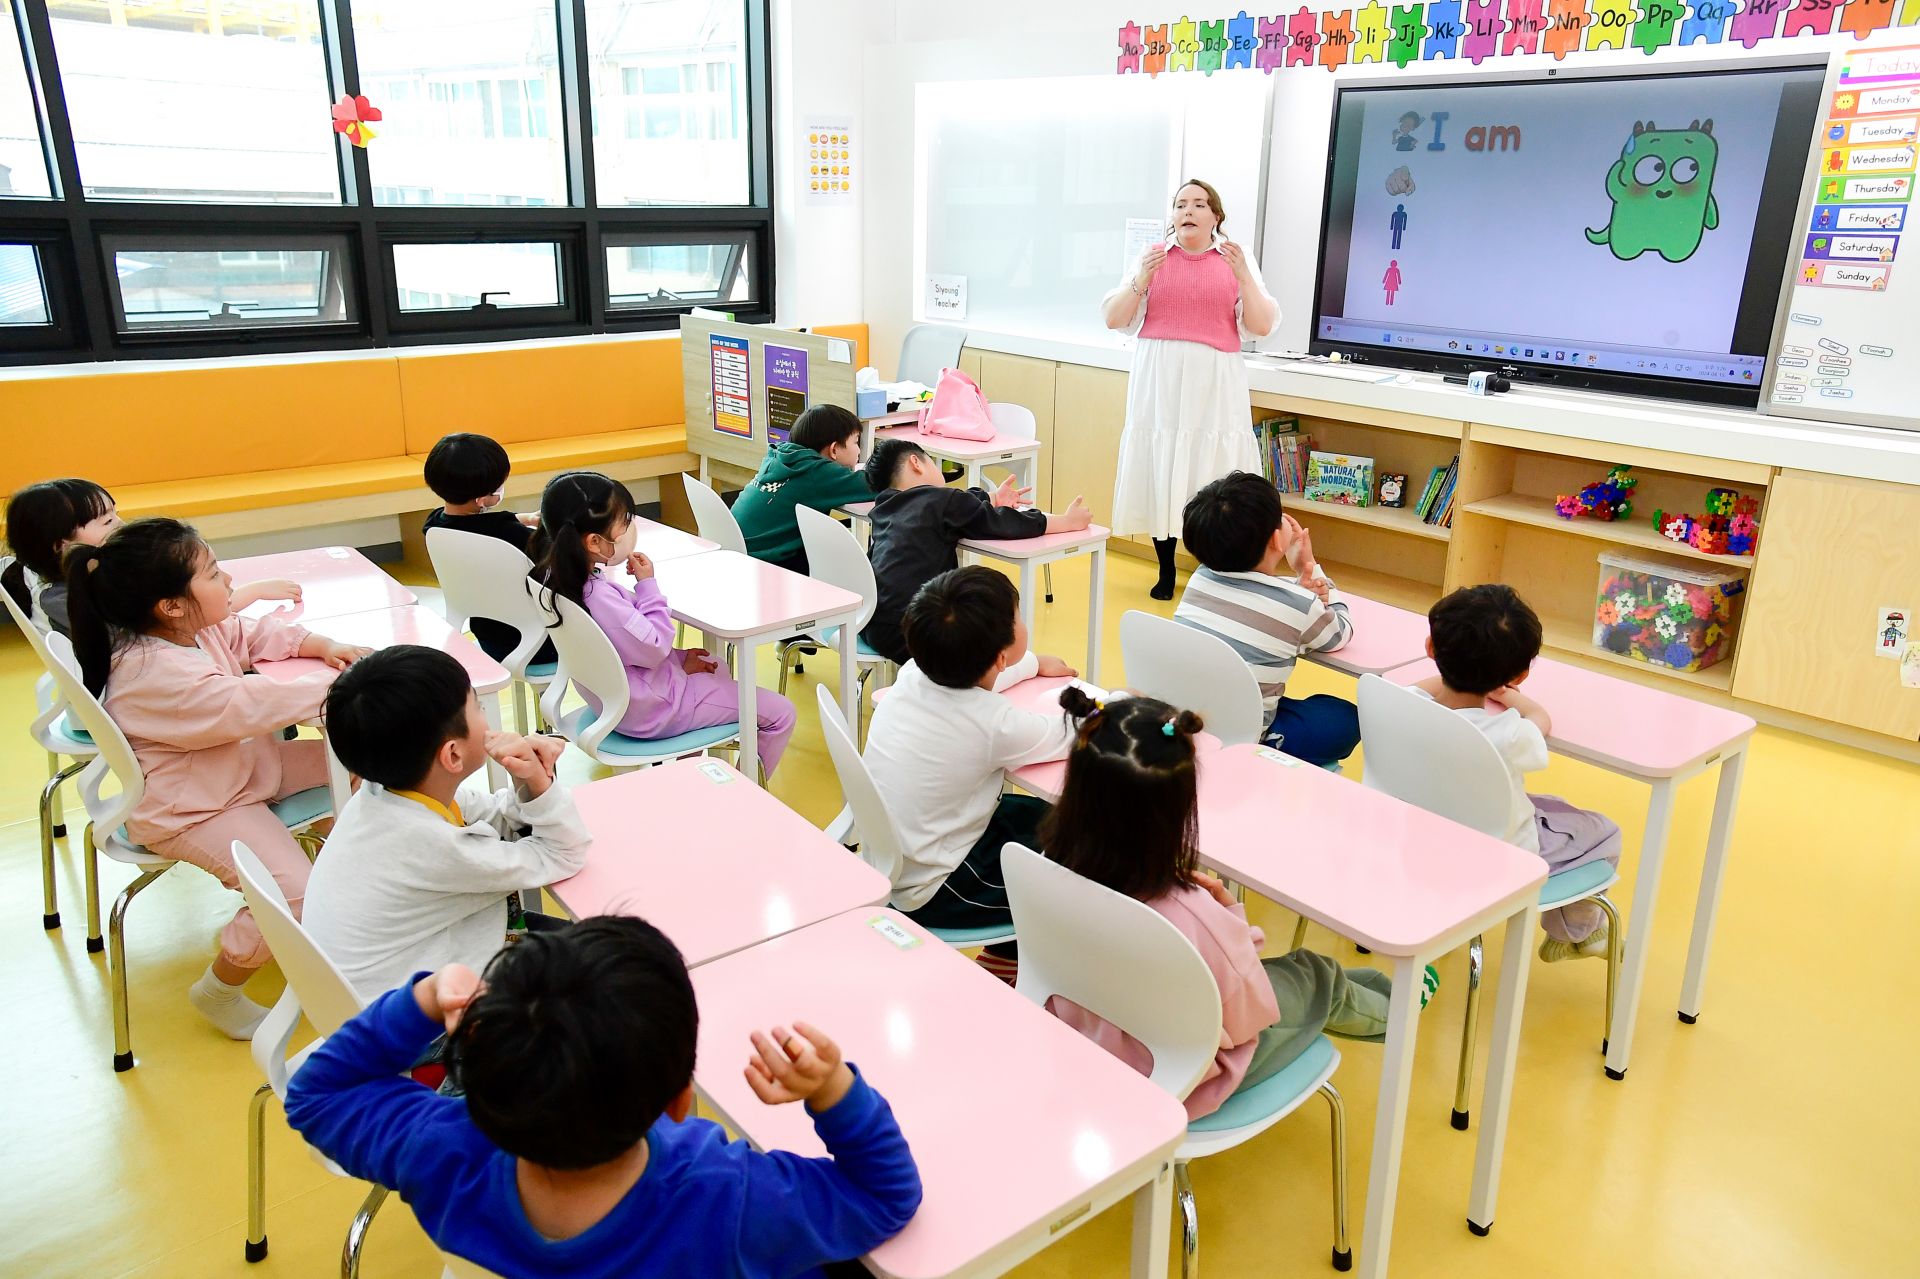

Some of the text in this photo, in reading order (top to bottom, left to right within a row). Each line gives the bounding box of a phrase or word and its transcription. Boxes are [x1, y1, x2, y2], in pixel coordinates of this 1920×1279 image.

[1123, 42, 1139, 57] Aa
[1149, 41, 1165, 56] Bb
[1178, 39, 1193, 54] Cc
[1205, 36, 1221, 53] Dd
[1234, 35, 1252, 51] Ee
[1264, 32, 1281, 50] Ff
[1294, 31, 1314, 53] Gg
[1328, 25, 1347, 46] Hh
[1366, 26, 1376, 45] Ii
[1397, 24, 1416, 48] Jj
[1434, 21, 1455, 40] Kk
[1514, 15, 1538, 34] Mm
[1555, 11, 1581, 31] Nn
[1601, 9, 1627, 28] Oo
[1647, 3, 1673, 28] Pp
[1696, 2, 1724, 24] Qq
[1871, 95, 1912, 106] Monday
[1427, 112, 1521, 152] I am
[1861, 125, 1904, 137] Tuesday
[1852, 152, 1911, 165] Wednesday
[1854, 183, 1901, 194] Thursday
[1848, 212, 1881, 224] Friday
[1839, 241, 1885, 253] Saturday
[1836, 270, 1871, 282] Sunday
[934, 297, 959, 308] Teacher
[1323, 465, 1356, 477] NATURAL
[1321, 476, 1357, 488] WONDERS
